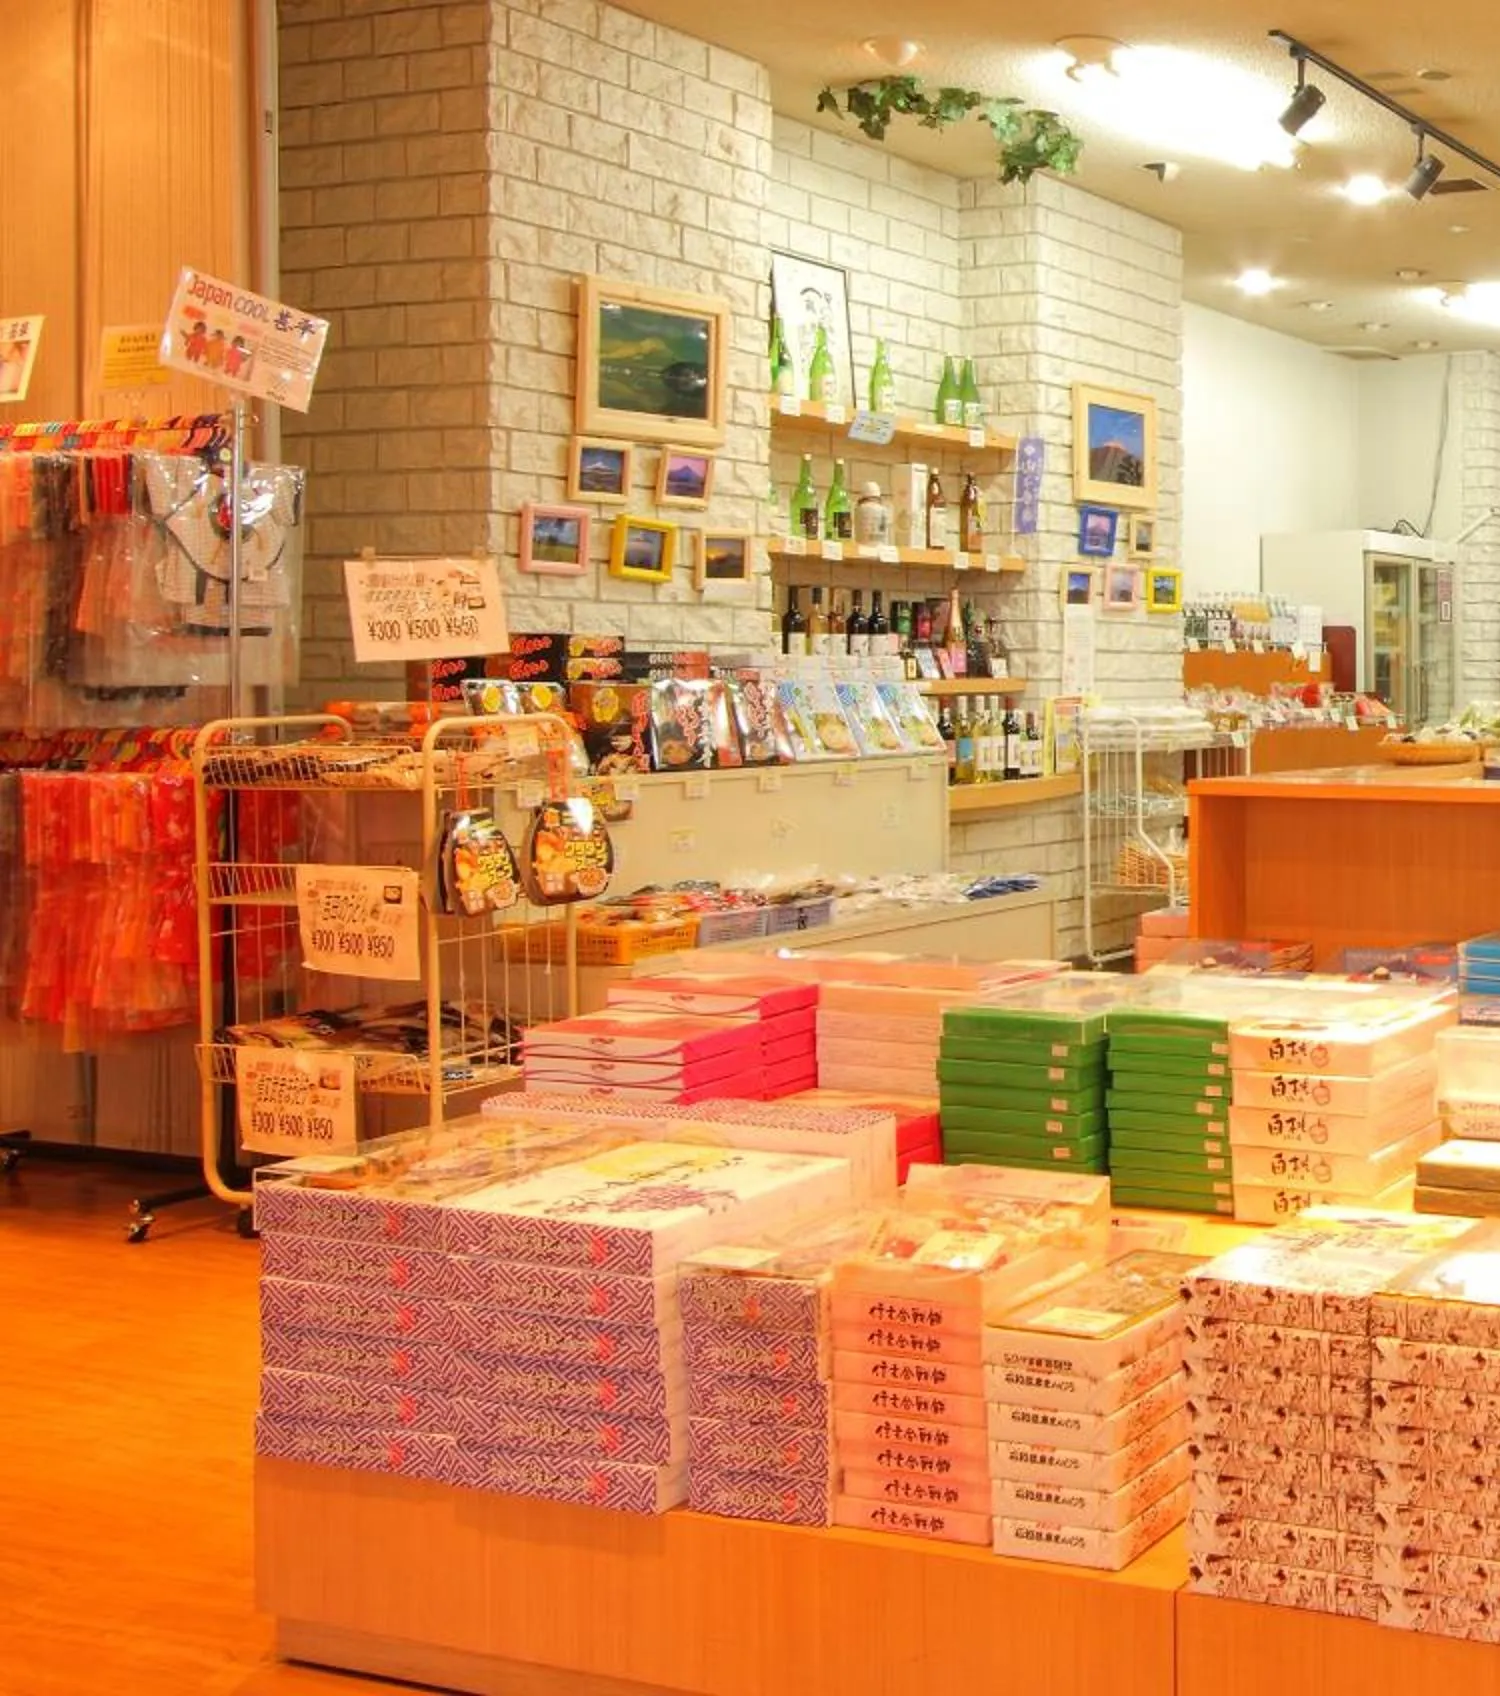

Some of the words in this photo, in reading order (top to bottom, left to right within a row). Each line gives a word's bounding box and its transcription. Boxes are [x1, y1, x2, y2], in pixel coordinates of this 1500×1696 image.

[187, 274, 234, 312] Japan
[367, 618, 401, 641] ¥300
[406, 616, 441, 640] ¥500
